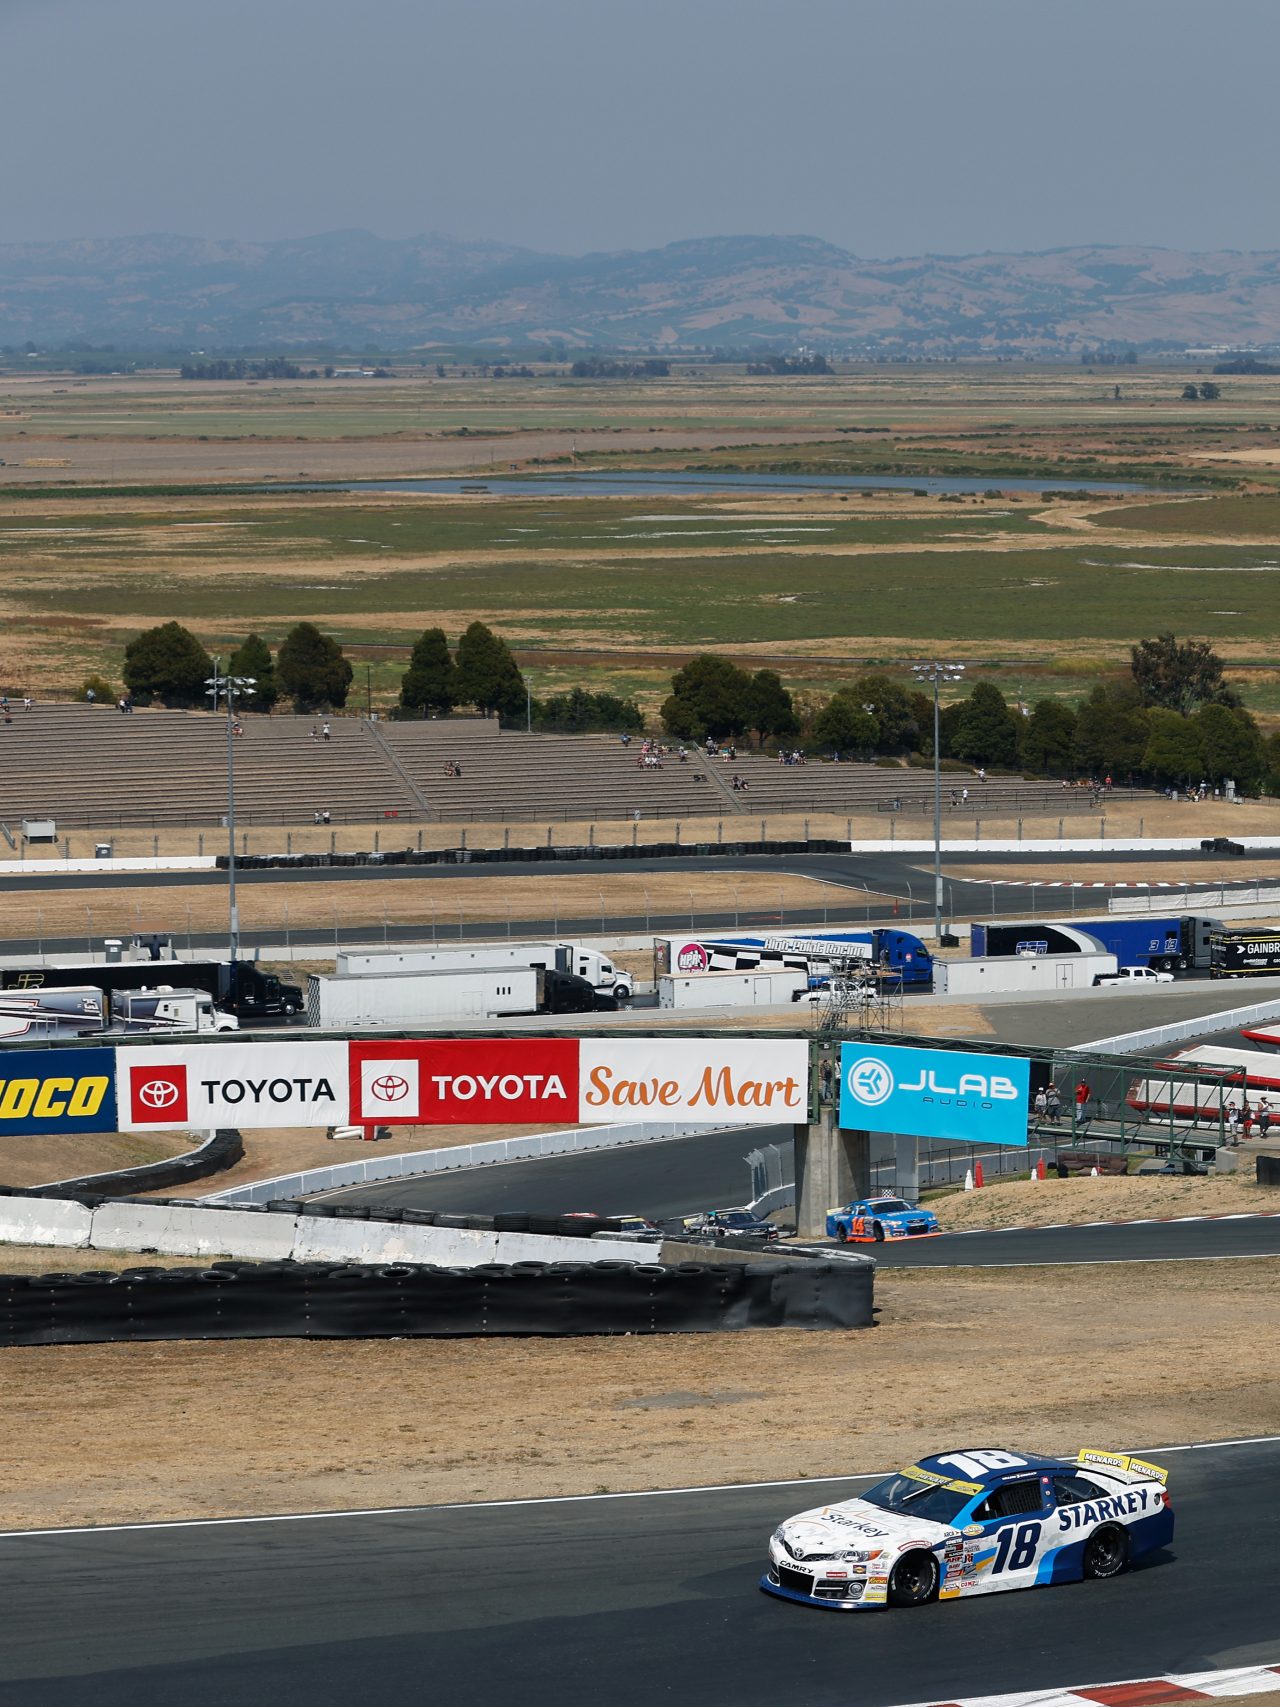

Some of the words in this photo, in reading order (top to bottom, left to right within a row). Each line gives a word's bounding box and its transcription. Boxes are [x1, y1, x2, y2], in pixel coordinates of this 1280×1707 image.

[764, 936, 824, 955] High-Point
[0, 1076, 110, 1119] OCO
[201, 1078, 336, 1104] TOYOTA
[432, 1073, 568, 1100] TOYOTA
[585, 1066, 682, 1108] Save
[686, 1066, 802, 1108] Mart
[898, 1070, 1019, 1100] JLAB
[922, 1096, 993, 1110] AUDIO
[937, 1450, 1029, 1479] 18
[1085, 1453, 1123, 1467] MENARDS
[1130, 1463, 1165, 1481] MENARDS
[1058, 1488, 1148, 1532] STARKEY
[820, 1512, 889, 1539] Starkey
[992, 1522, 1042, 1575] 18
[779, 1560, 815, 1575] CAMRY
